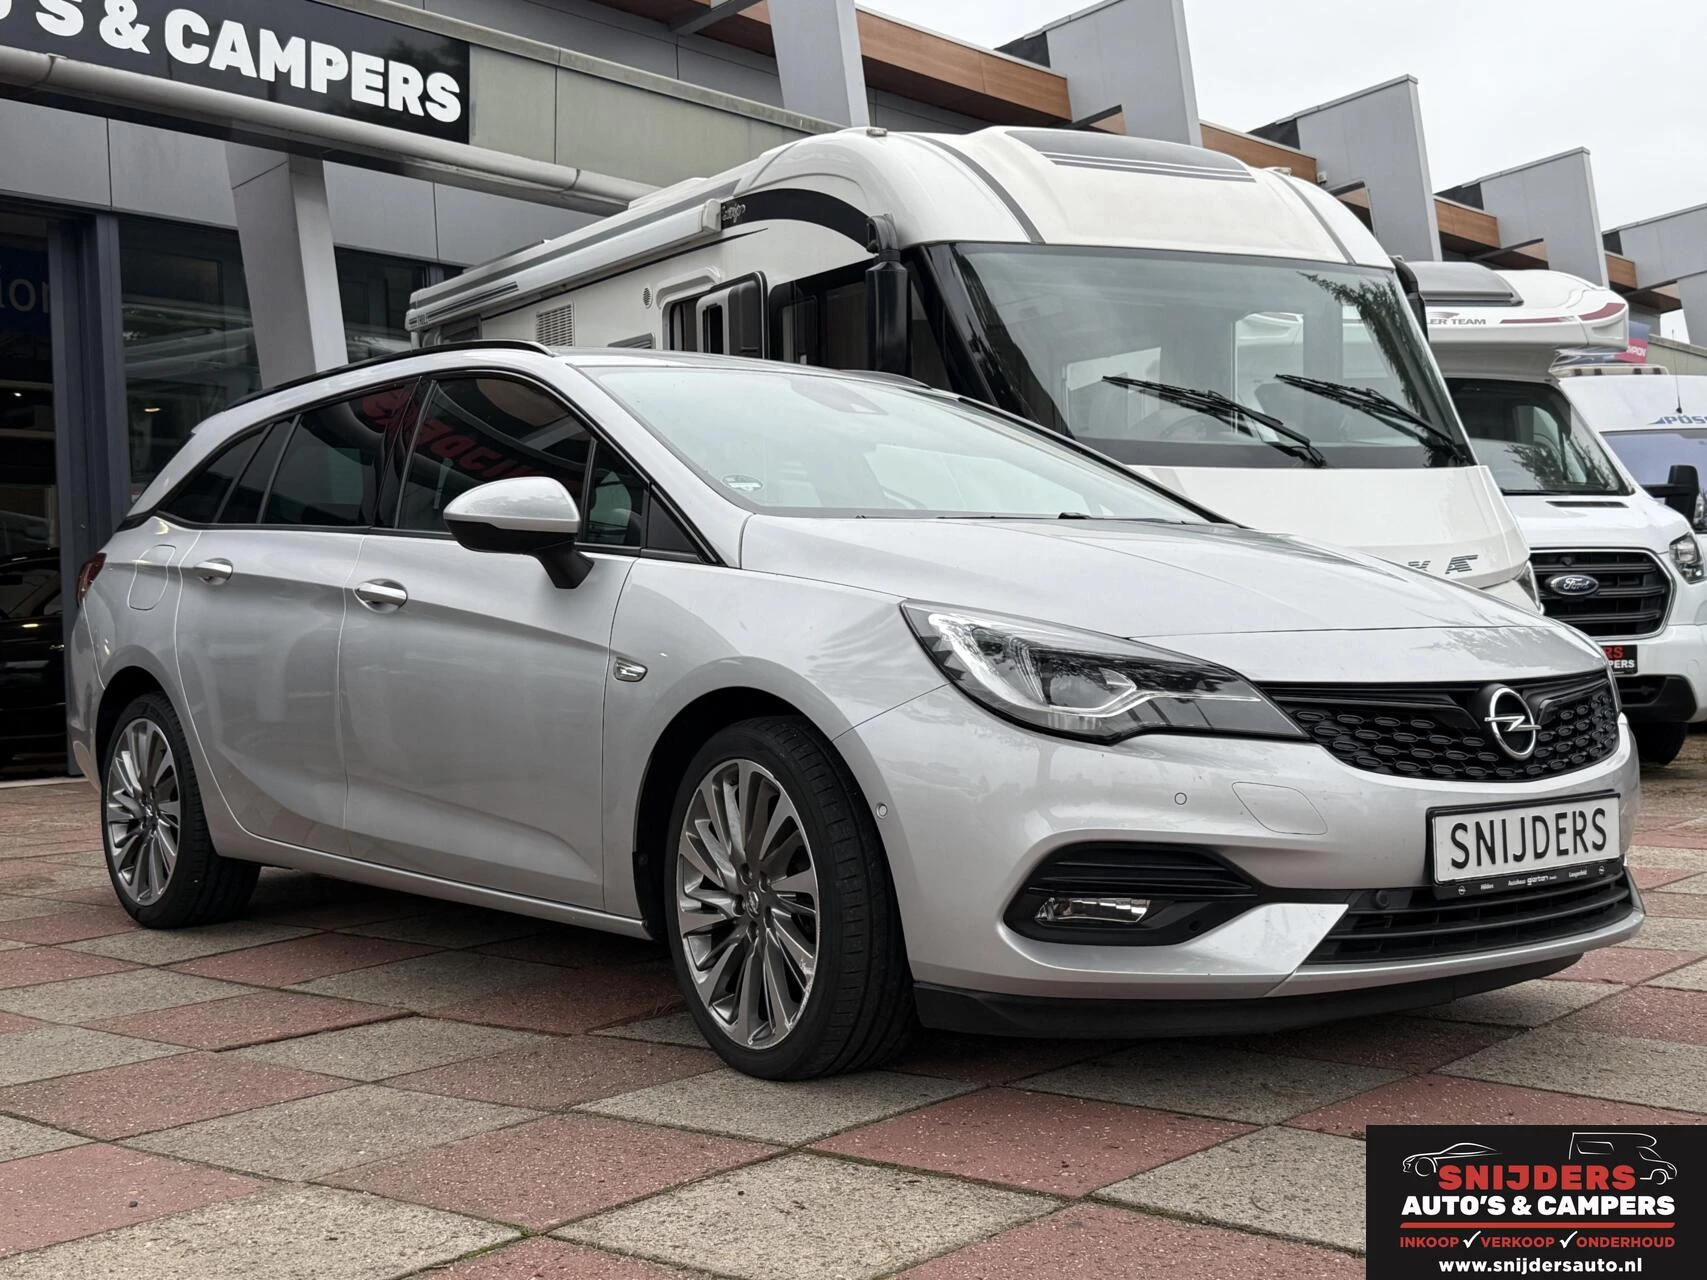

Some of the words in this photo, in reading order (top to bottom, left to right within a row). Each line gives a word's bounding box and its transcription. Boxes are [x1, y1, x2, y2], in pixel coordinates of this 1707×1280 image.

[99, 0, 150, 54] &
[164, 8, 462, 122] CAMPERS
[1665, 413, 1707, 424] PÖS
[1563, 577, 1590, 590] Ford
[1450, 807, 1608, 870] SNIJDERS
